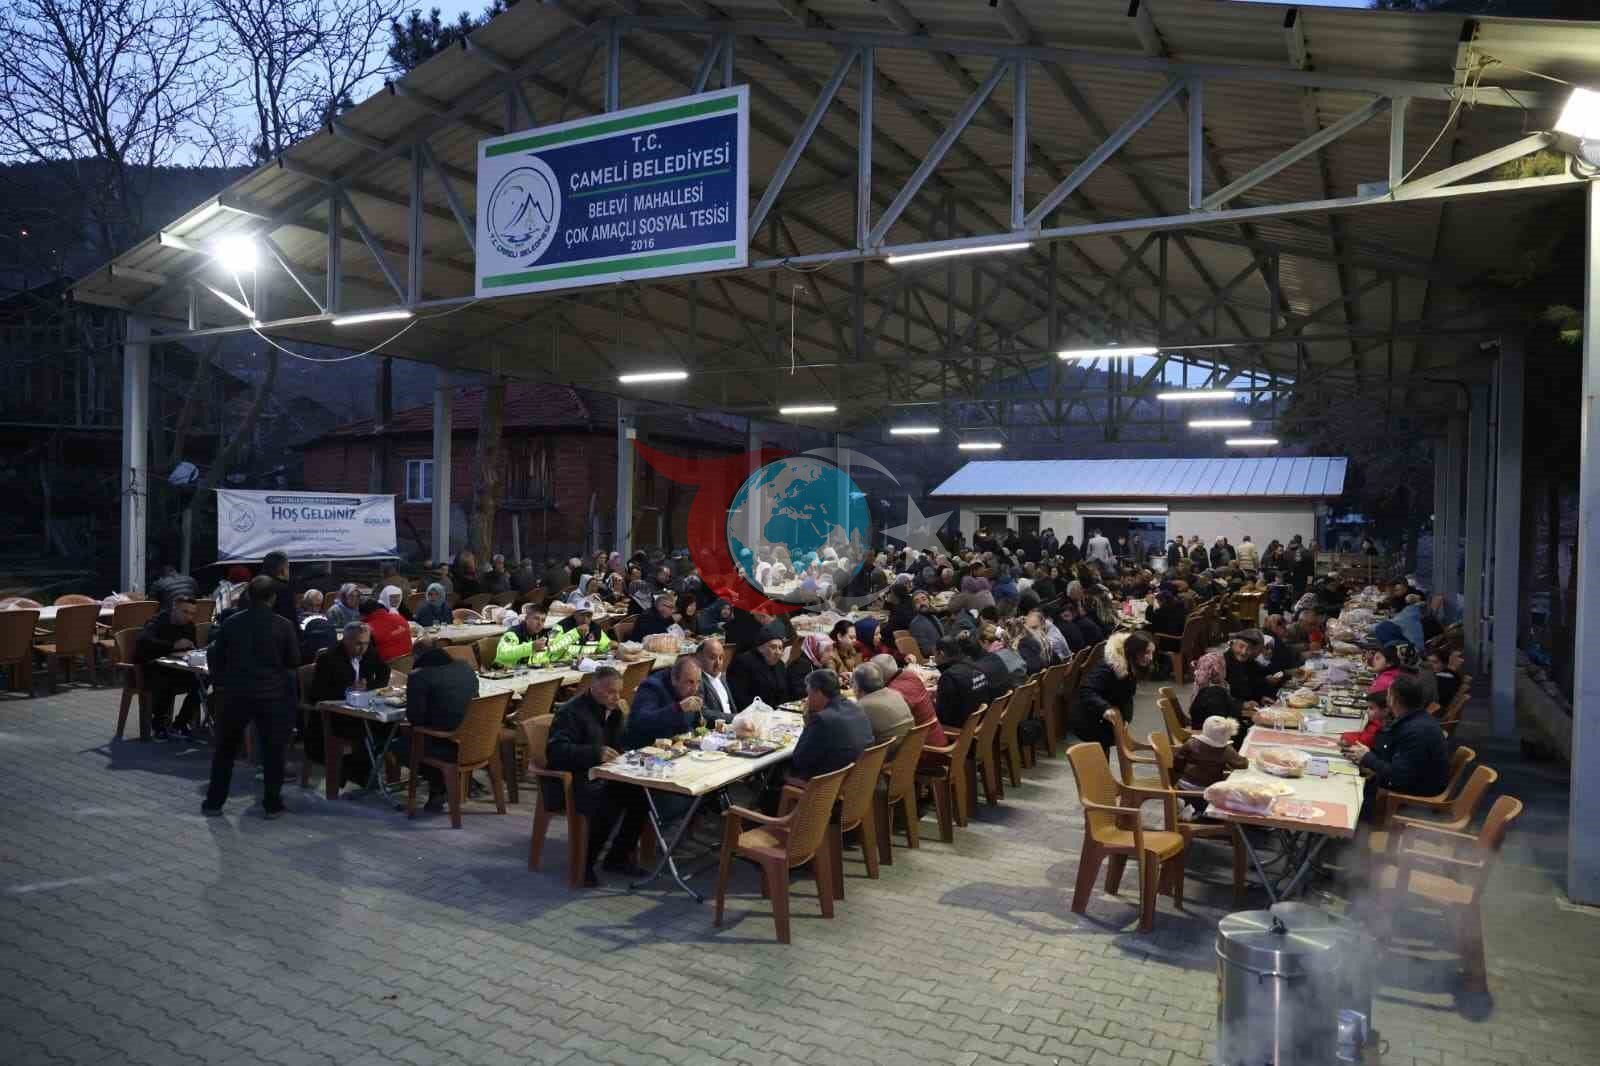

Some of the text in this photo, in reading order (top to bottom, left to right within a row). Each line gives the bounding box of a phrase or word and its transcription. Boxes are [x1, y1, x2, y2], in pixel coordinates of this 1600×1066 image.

[631, 133, 663, 153] T.C.
[569, 142, 730, 191] ÇAMELİ BELEDİYESİ
[588, 181, 703, 219] BELEVİ MAHALLESİ
[565, 228, 588, 249] ÇOK
[591, 221, 636, 244] AMAÇLI
[639, 212, 688, 235] SOSYAL
[690, 203, 730, 227] TESİSİ
[631, 238, 655, 252] 2016
[271, 505, 298, 522] HOŞ
[301, 506, 357, 521] GELDİNİZ
